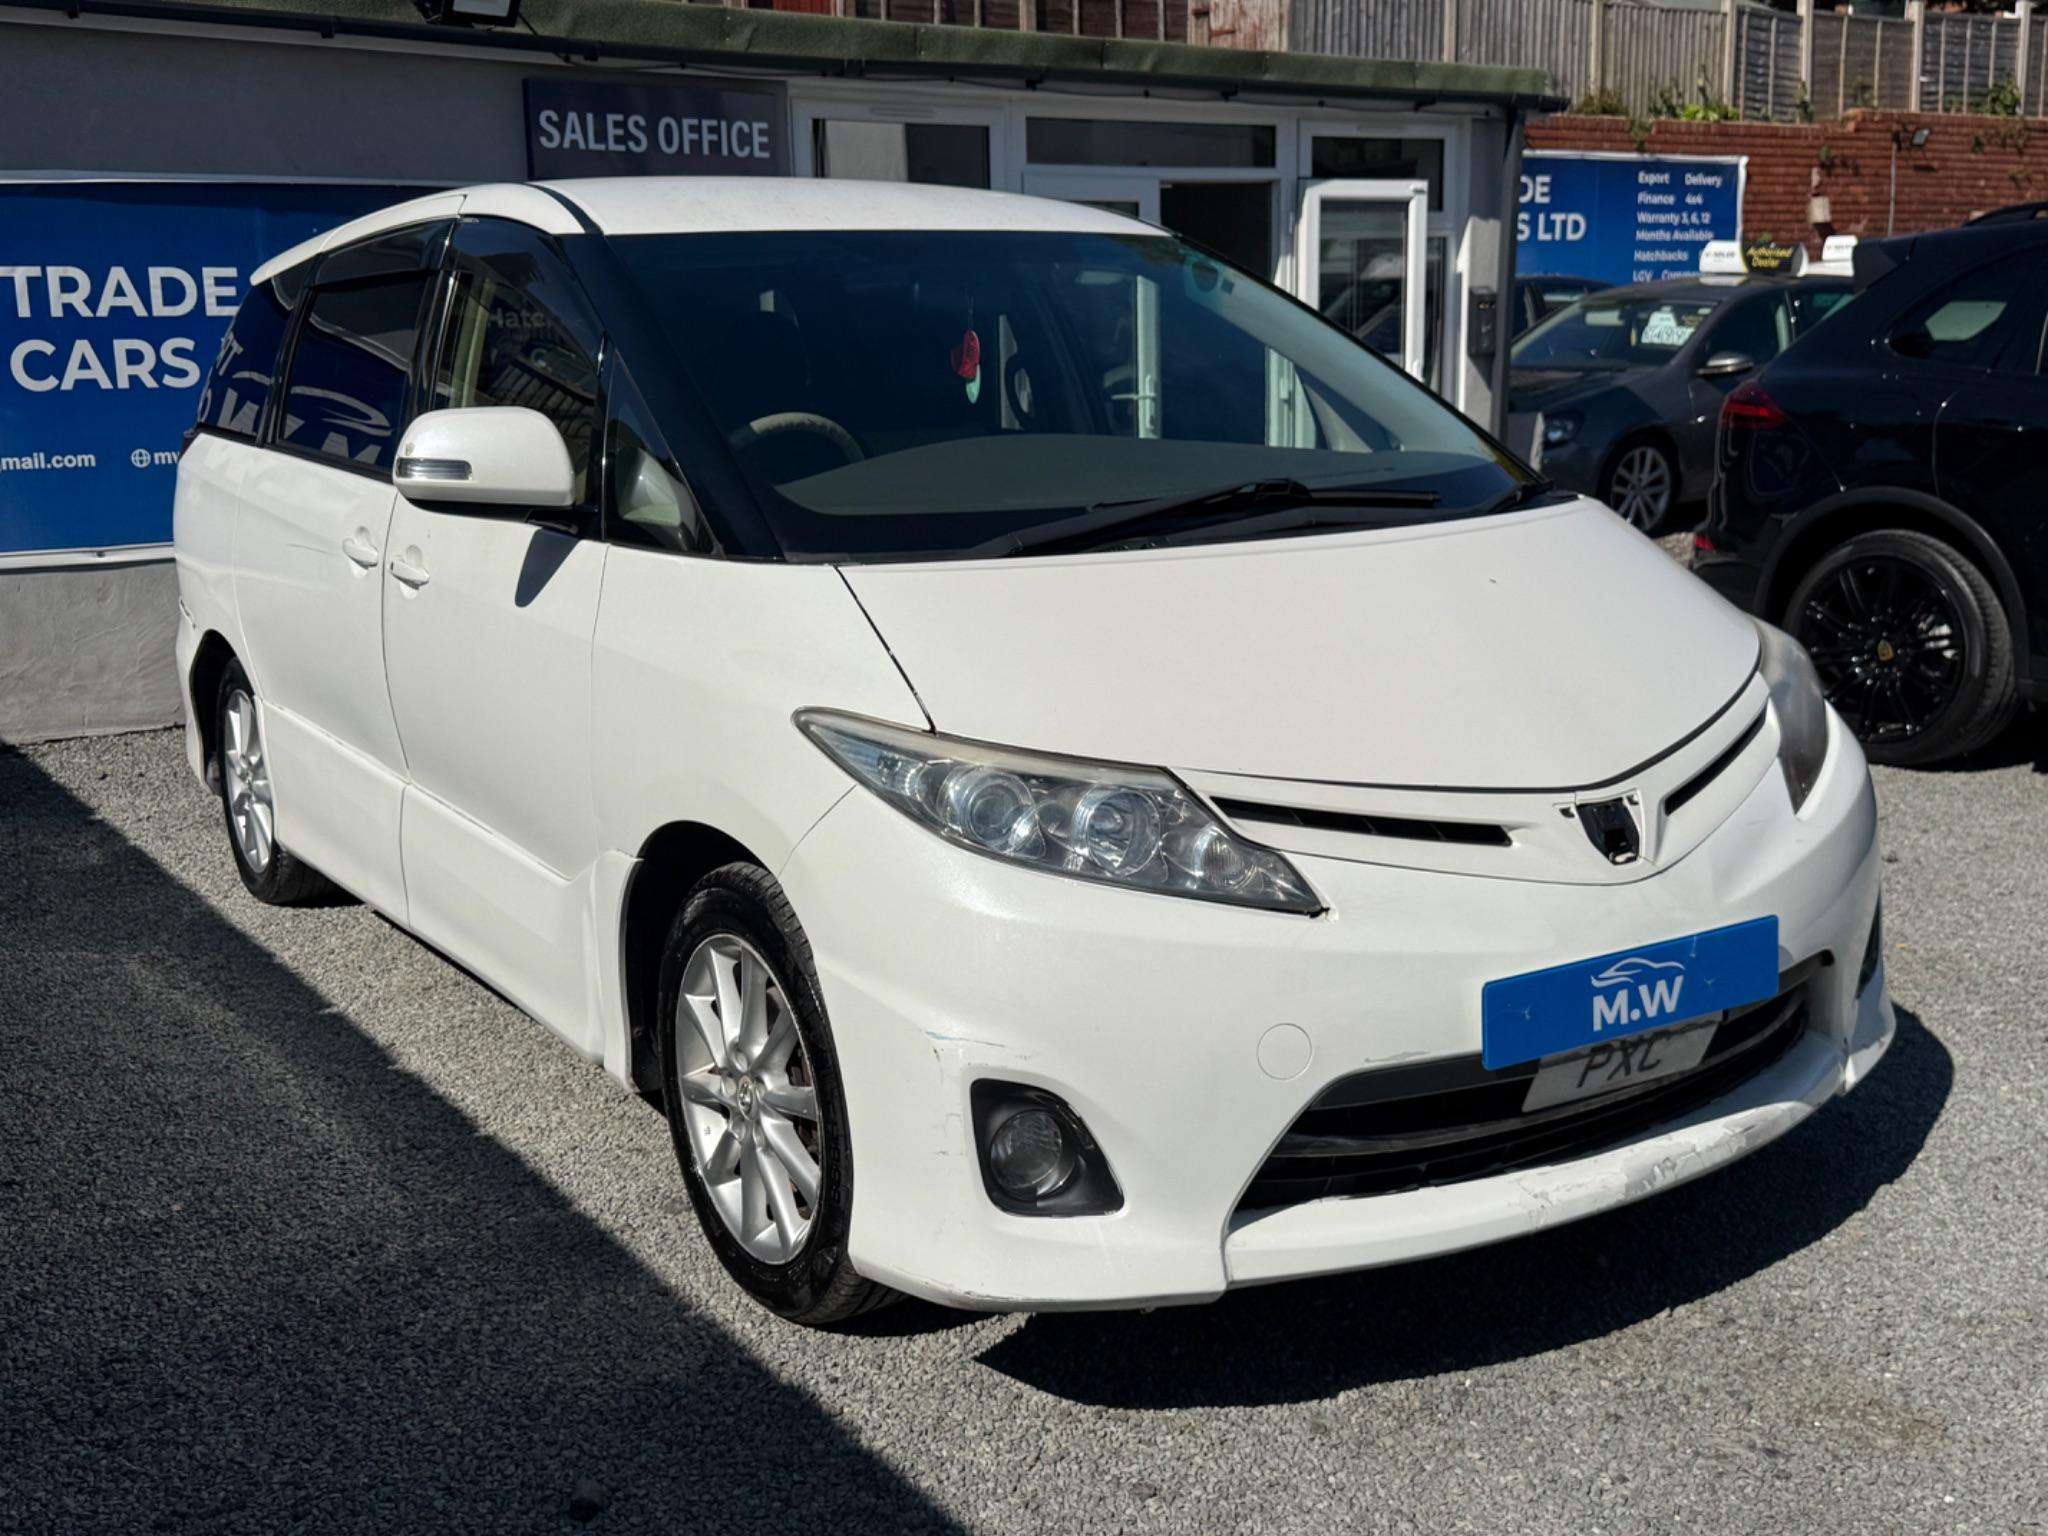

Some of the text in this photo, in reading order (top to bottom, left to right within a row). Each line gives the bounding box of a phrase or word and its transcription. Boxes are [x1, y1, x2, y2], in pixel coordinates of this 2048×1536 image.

[538, 109, 770, 158] SALES OFFICE
[1638, 171, 1670, 185] Export
[1685, 173, 1722, 187] Delivery
[1638, 192, 1675, 205] Finance
[1537, 212, 1586, 241] LTD
[1637, 211, 1680, 226] Warranty
[1636, 229, 1714, 241] Months Available
[1634, 249, 1689, 262] Hatchbacks
[0, 266, 240, 318] TRADE
[10, 337, 201, 392] CARS
[0, 451, 96, 473] mail.com
[1593, 975, 1684, 1031] M.W
